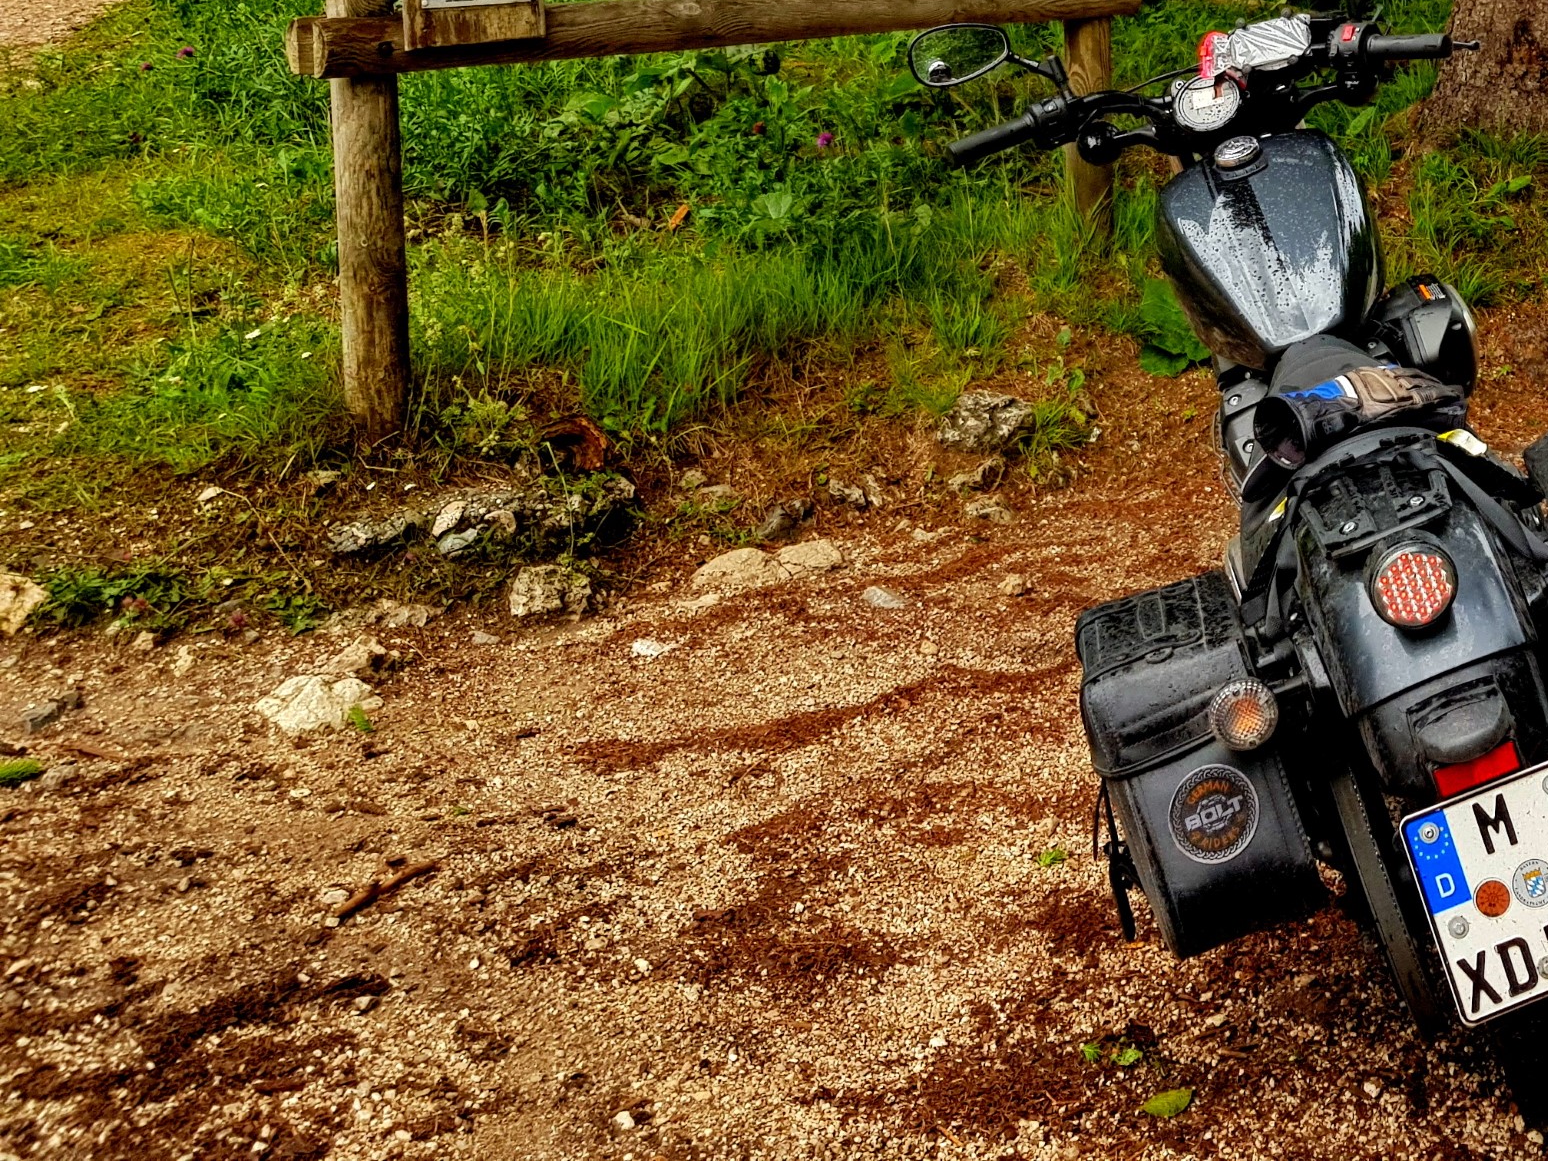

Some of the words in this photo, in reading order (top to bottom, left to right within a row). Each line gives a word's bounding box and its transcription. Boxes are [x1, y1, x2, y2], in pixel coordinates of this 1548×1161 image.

[1184, 794, 1243, 831] BOLT
[1471, 792, 1519, 855] M
[1435, 872, 1456, 898] D
